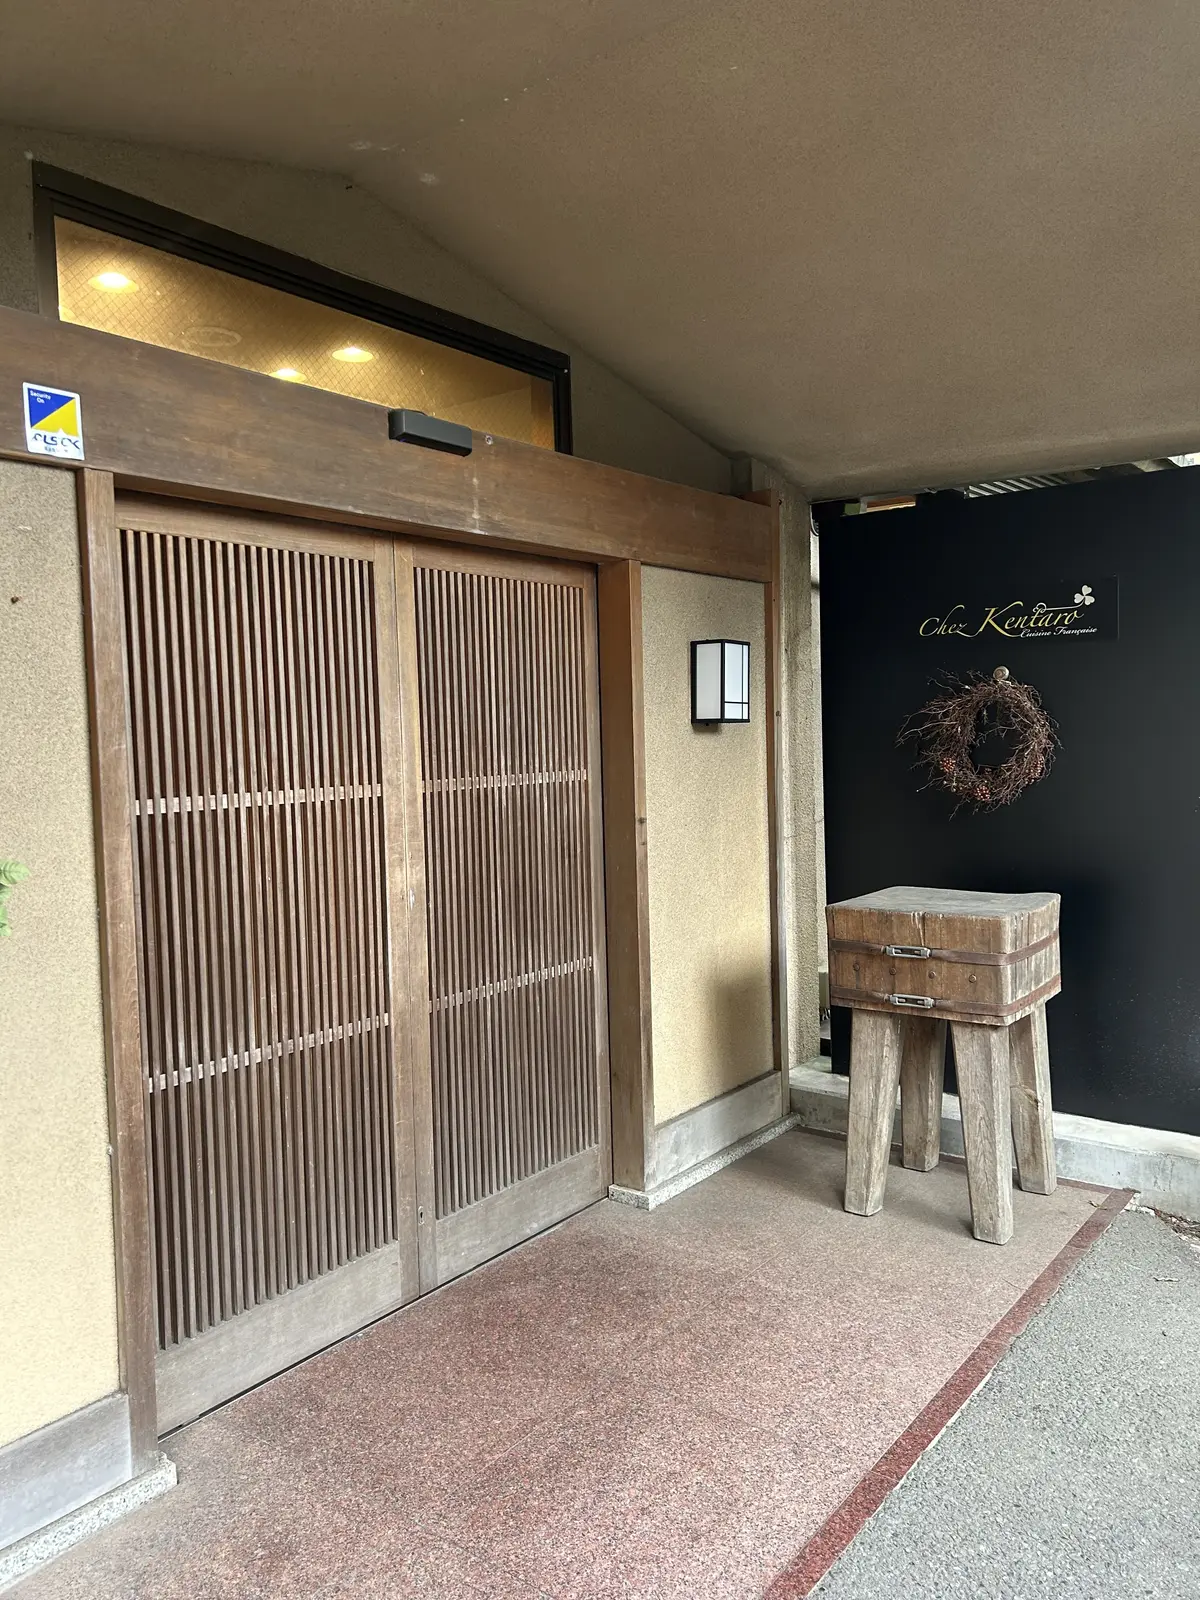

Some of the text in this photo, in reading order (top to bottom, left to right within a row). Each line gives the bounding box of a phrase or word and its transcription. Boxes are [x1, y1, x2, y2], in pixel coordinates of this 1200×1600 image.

[30, 390, 51, 400] Security
[919, 601, 1084, 637] Chez Kentaro
[1020, 626, 1098, 638] Cuisine Française
